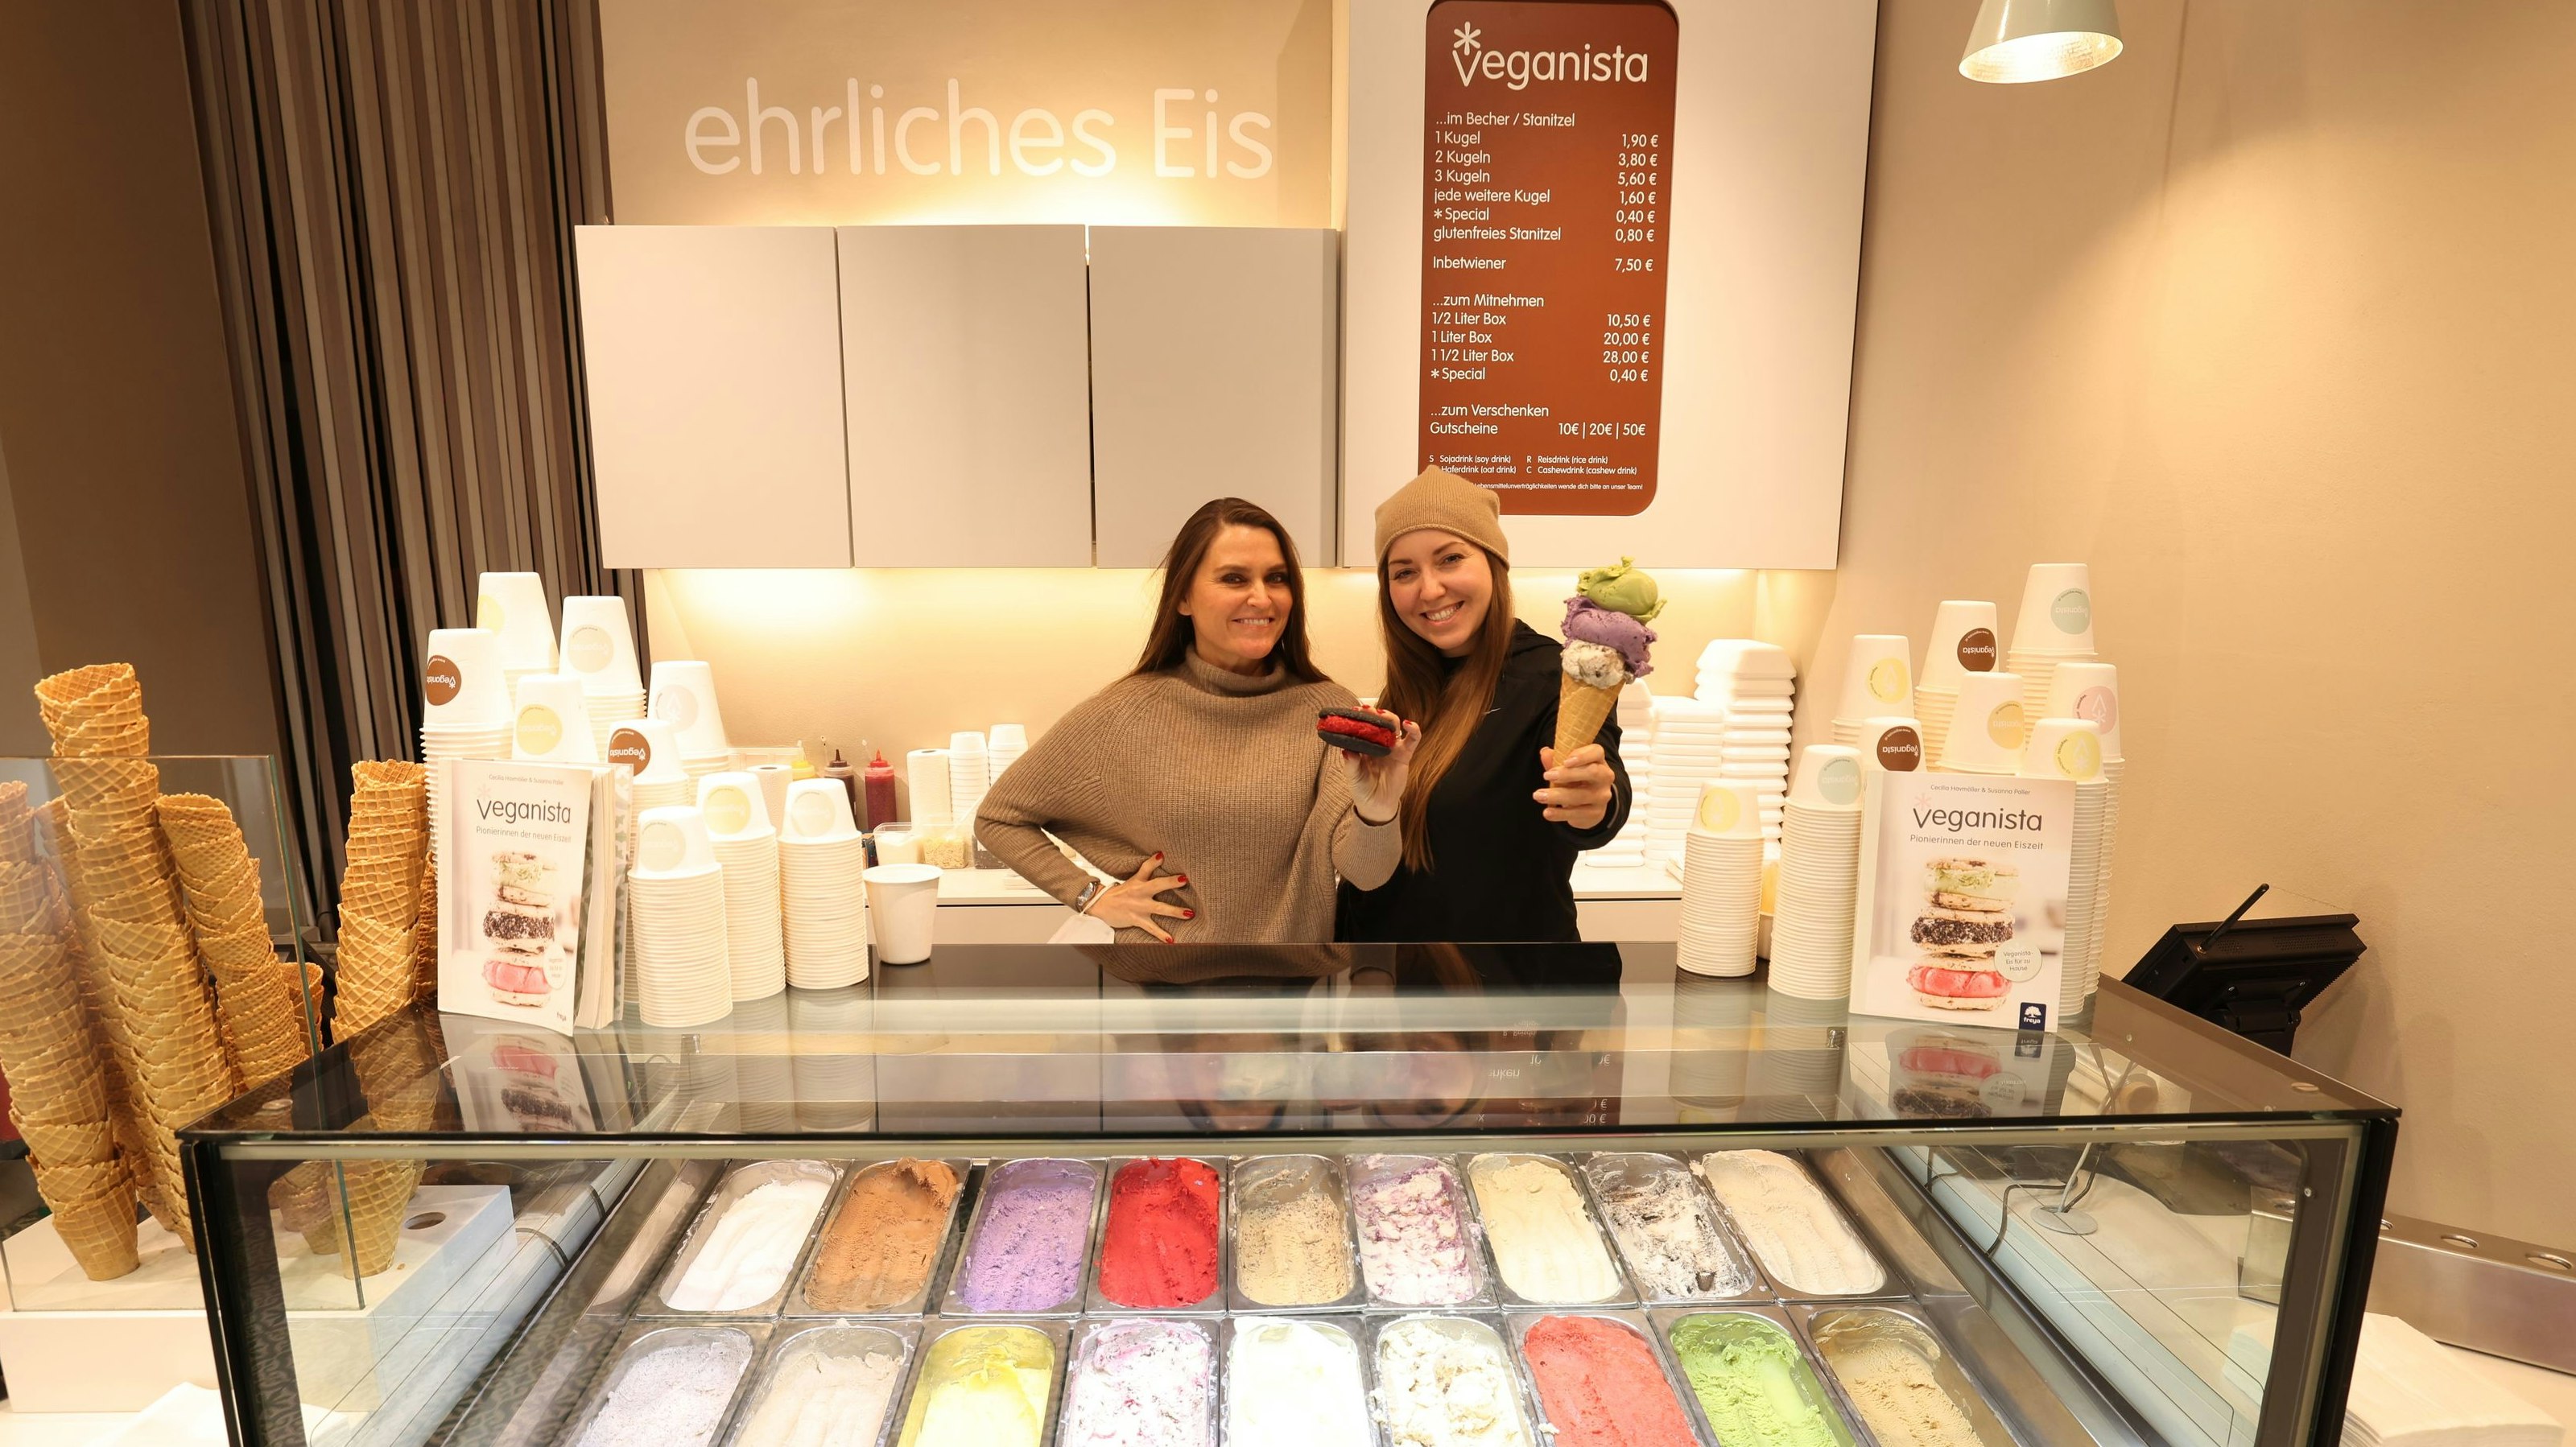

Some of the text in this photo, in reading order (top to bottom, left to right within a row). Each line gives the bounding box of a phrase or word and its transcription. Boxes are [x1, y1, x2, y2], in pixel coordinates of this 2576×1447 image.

[1467, 112, 1509, 125] Becher
[1524, 113, 1575, 126] Stanitzel
[685, 77, 1273, 179] ehrliches Eis
[1436, 131, 1480, 146] 1 Kugel
[1623, 134, 1657, 148] 1,90 €
[1436, 150, 1490, 166] 2 Kugeln
[1619, 154, 1657, 167] 3,80 €
[1435, 169, 1489, 185] 3 Kugeln
[1618, 172, 1656, 186] 5,60 €
[1435, 188, 1550, 205] jede weitere Kugel
[1620, 192, 1655, 205] 1,60 €
[1446, 208, 1488, 223] Special
[1616, 210, 1655, 224] 0,40 €
[1435, 226, 1560, 241] glutenfreies Stanitzel
[1616, 229, 1654, 242] 0,80 €
[1434, 256, 1506, 269] Inbetwiener
[1616, 258, 1653, 272] 7,50 €
[1474, 294, 1543, 307] Mitnehmen
[1433, 312, 1505, 324] 1/2 Liter Box
[1608, 315, 1650, 328] 10,50 €
[1433, 331, 1492, 343] 1 Liter Box
[1604, 332, 1649, 346] 20,00 €
[1432, 349, 1513, 361] 1 1/2 Liter Box
[1604, 351, 1649, 365] 28,00 €
[1443, 367, 1485, 381] Special
[1610, 369, 1648, 382] 0,40 €
[1472, 404, 1548, 416] Verschenken
[1430, 422, 1497, 434] Gutscheine
[1559, 423, 1579, 435] 10€
[1590, 423, 1612, 435] 20€
[1623, 424, 1645, 435] 50€
[1440, 456, 1472, 464] Sojadrink
[1475, 456, 1489, 464] (soy
[1491, 456, 1511, 464] drink)
[1617, 467, 1637, 475] drink)
[477, 799, 572, 824] Veganista
[1913, 807, 2042, 832] Veganista
[476, 826, 572, 843] Pionierinnen der neuen Eiszeit
[1910, 834, 2044, 850] Pionierinnen der neuen Eiszeit
[2023, 1016, 2041, 1024] freya
